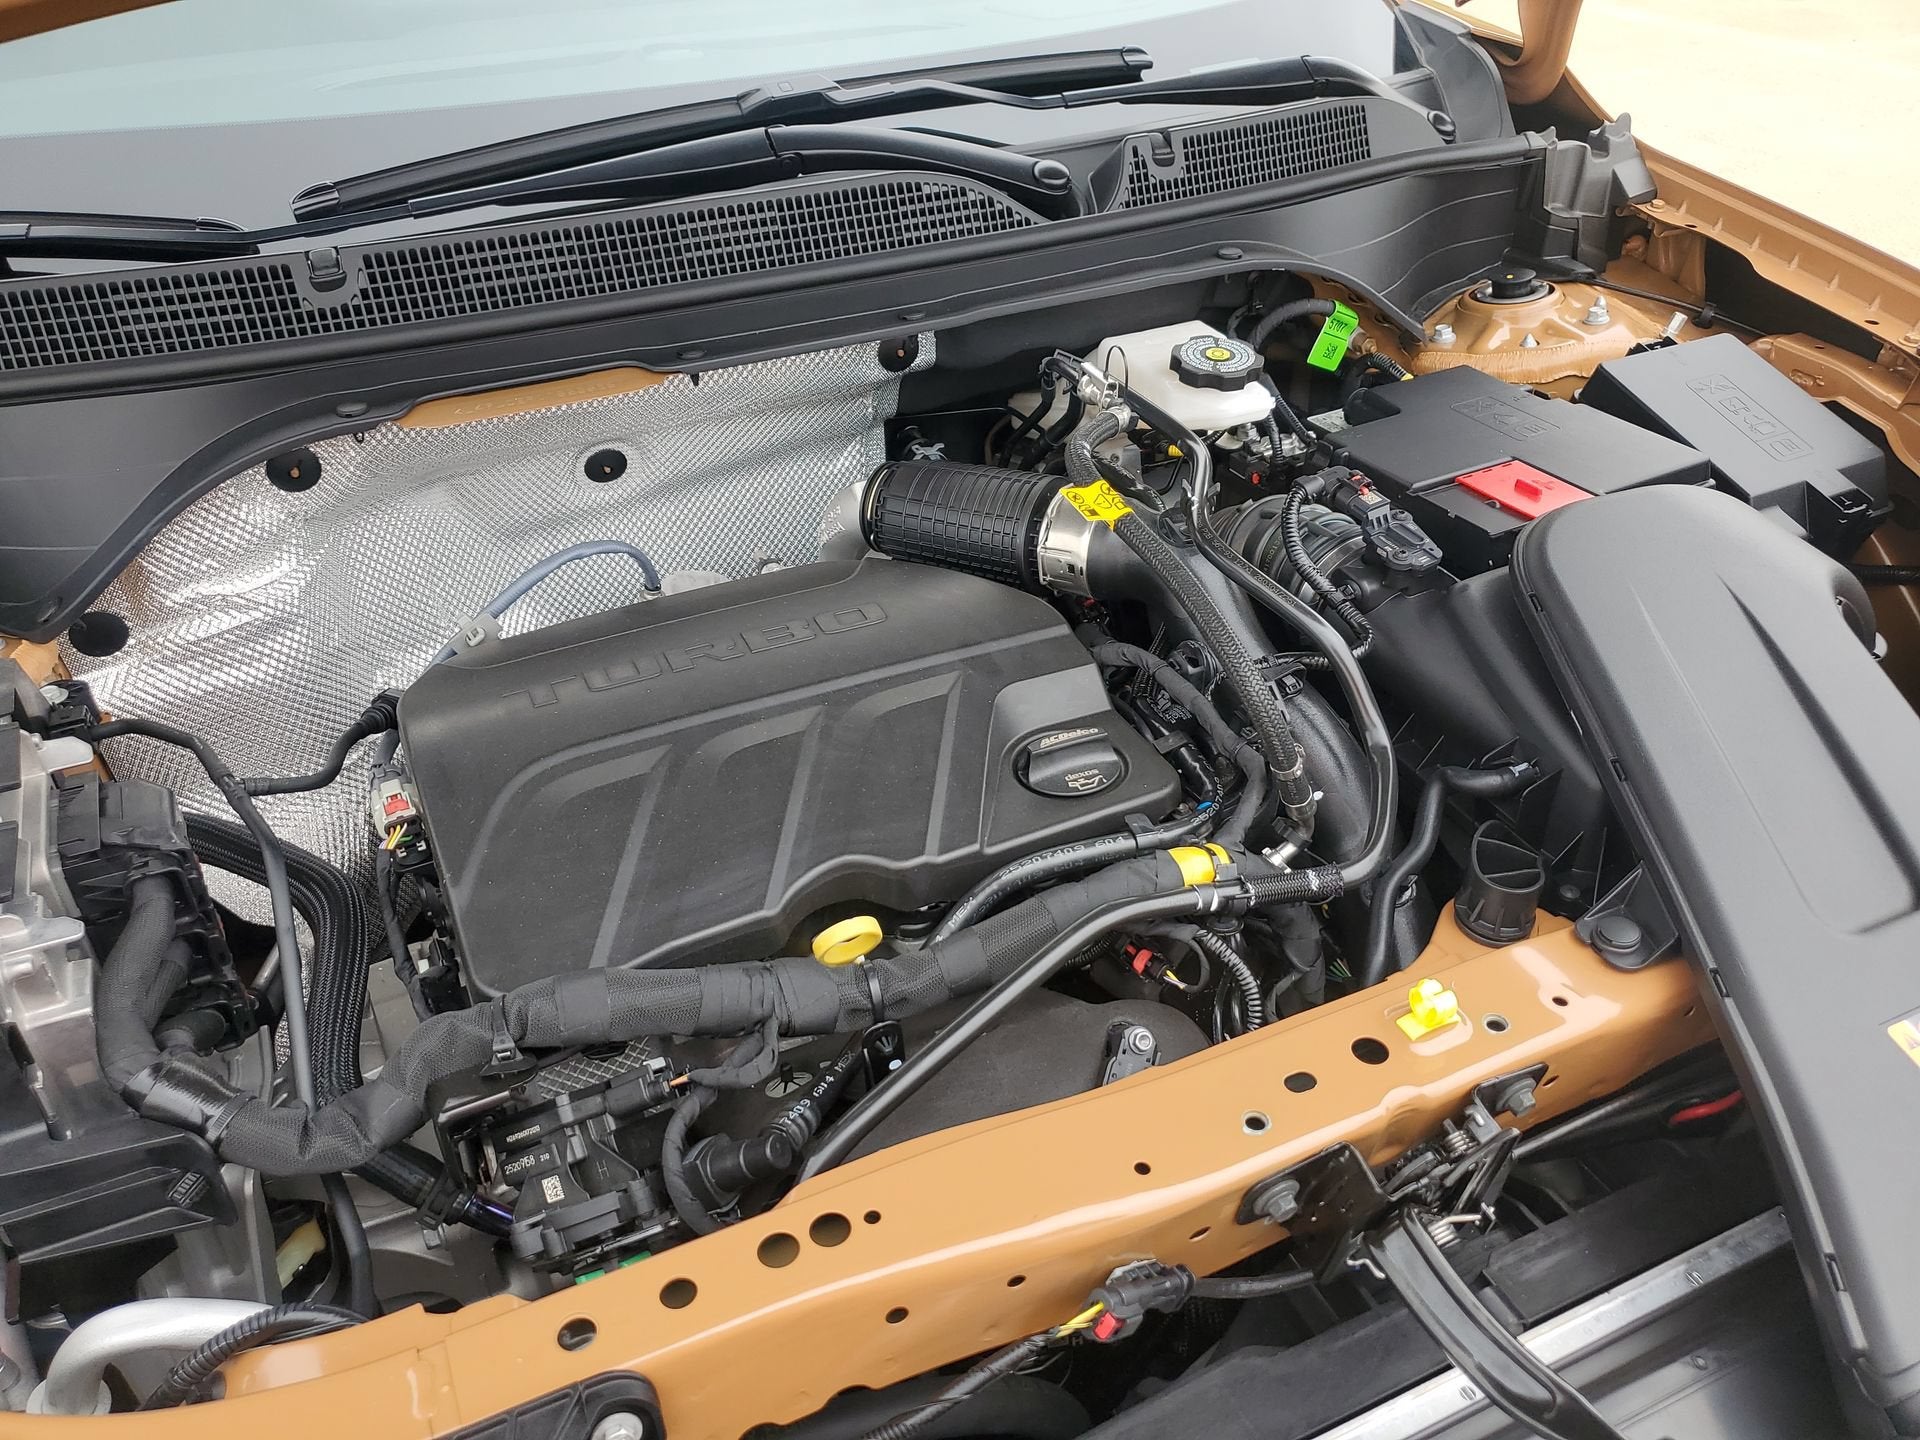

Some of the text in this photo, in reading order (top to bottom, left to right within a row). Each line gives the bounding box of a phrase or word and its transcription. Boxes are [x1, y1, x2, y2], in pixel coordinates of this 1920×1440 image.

[501, 600, 889, 709] TURBO
[1039, 727, 1099, 748] ACDelco
[1064, 768, 1100, 781] dexos
[999, 844, 1086, 880] 25207409
[947, 896, 977, 928] MEX
[833, 1050, 856, 1073] MEX
